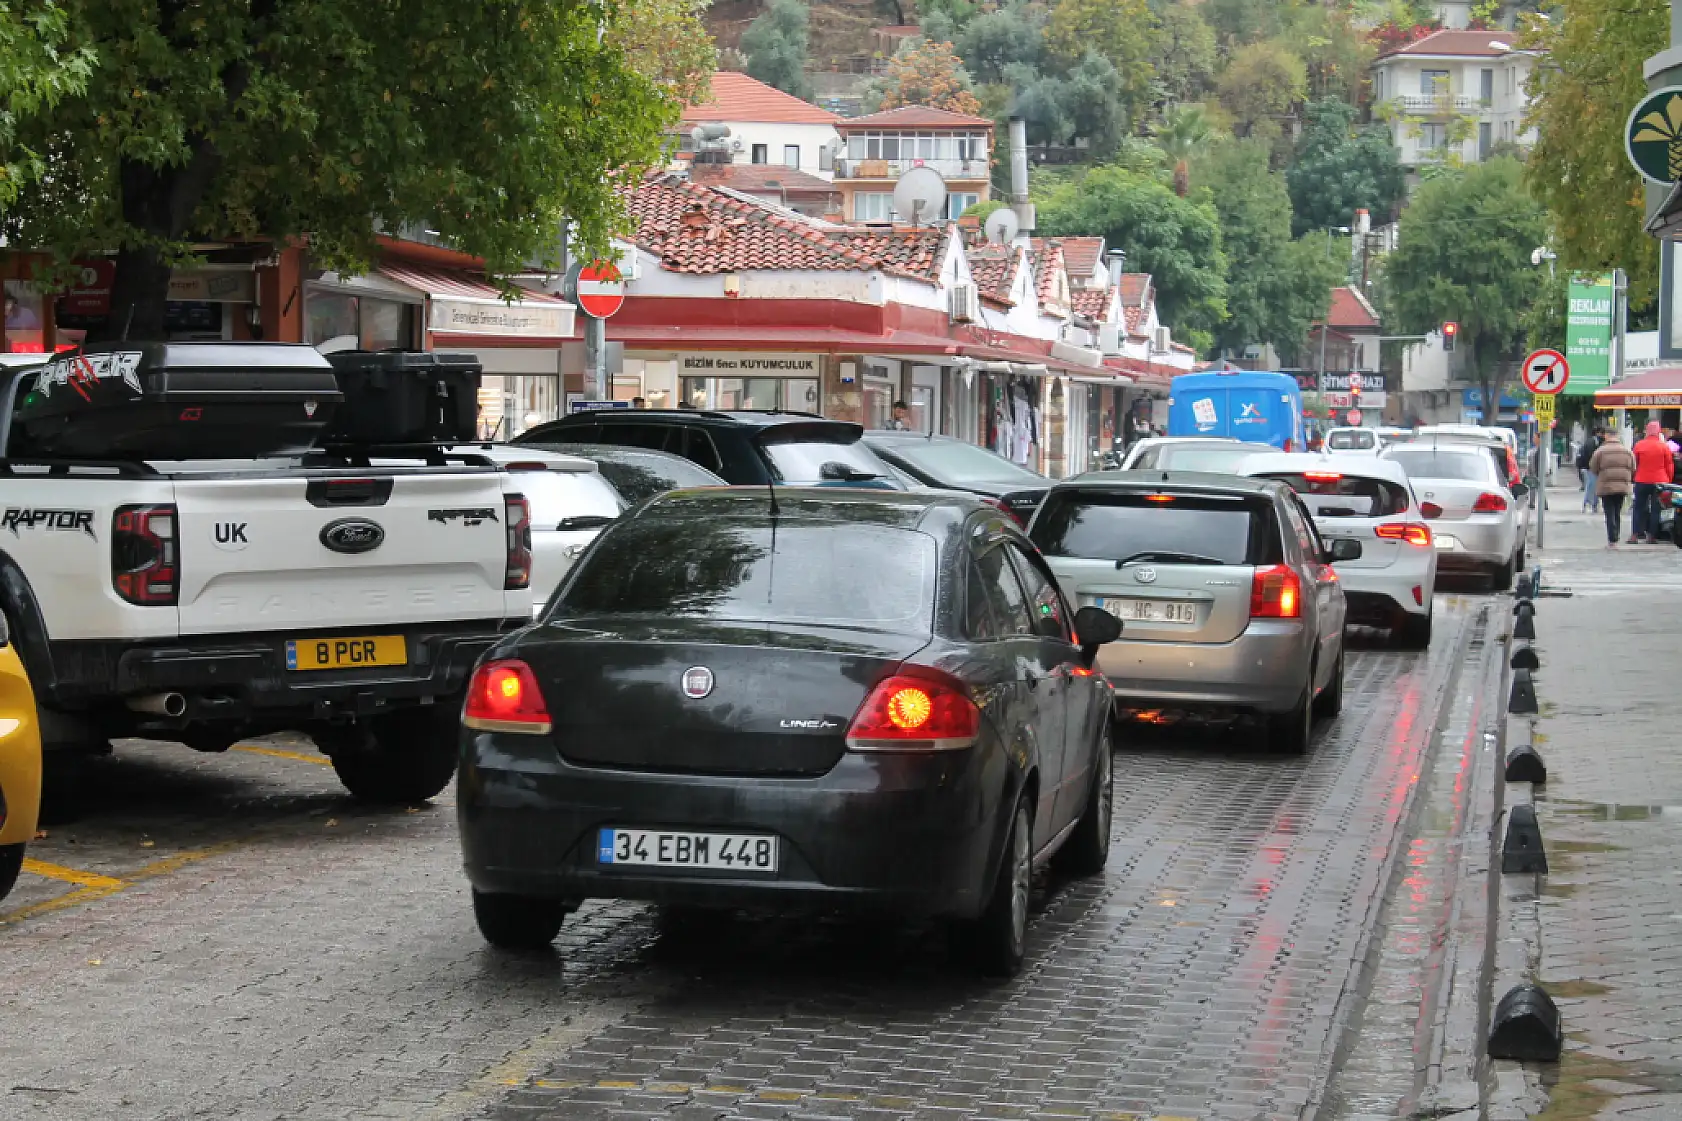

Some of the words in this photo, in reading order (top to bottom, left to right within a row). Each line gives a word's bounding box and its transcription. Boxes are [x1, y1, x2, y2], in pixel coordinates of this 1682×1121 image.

[684, 356, 714, 369] BİZİM
[740, 359, 813, 371] KUYUMCULUK
[1, 507, 98, 543] RAPTOR
[215, 522, 248, 543] UK
[335, 640, 377, 664] PGR
[780, 719, 837, 729] LINEA
[616, 833, 649, 861] 34
[658, 835, 709, 865] EBM
[719, 838, 770, 868] 448
